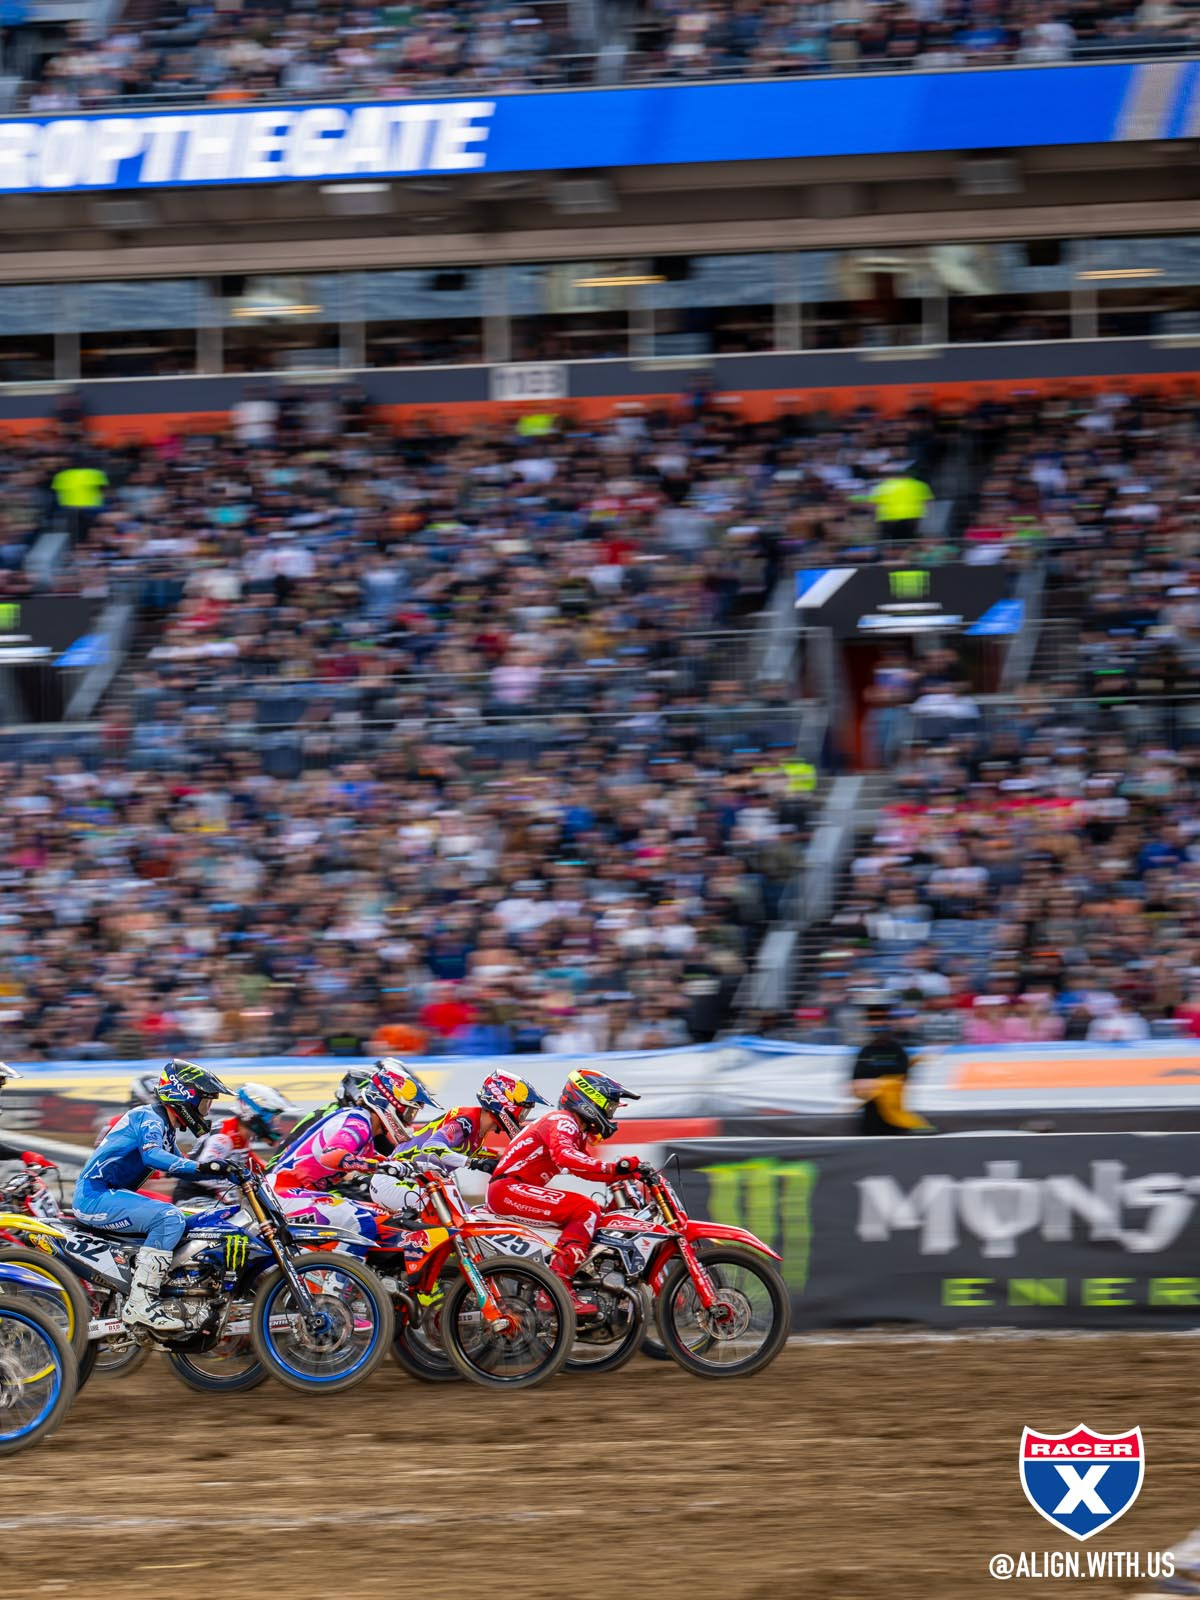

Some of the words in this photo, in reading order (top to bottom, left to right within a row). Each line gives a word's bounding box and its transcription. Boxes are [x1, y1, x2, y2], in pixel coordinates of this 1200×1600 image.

[169, 1075, 195, 1100] OAKLEY
[575, 1079, 604, 1105] 100%
[102, 1219, 131, 1230] AMAHA
[65, 1234, 111, 1263] 32
